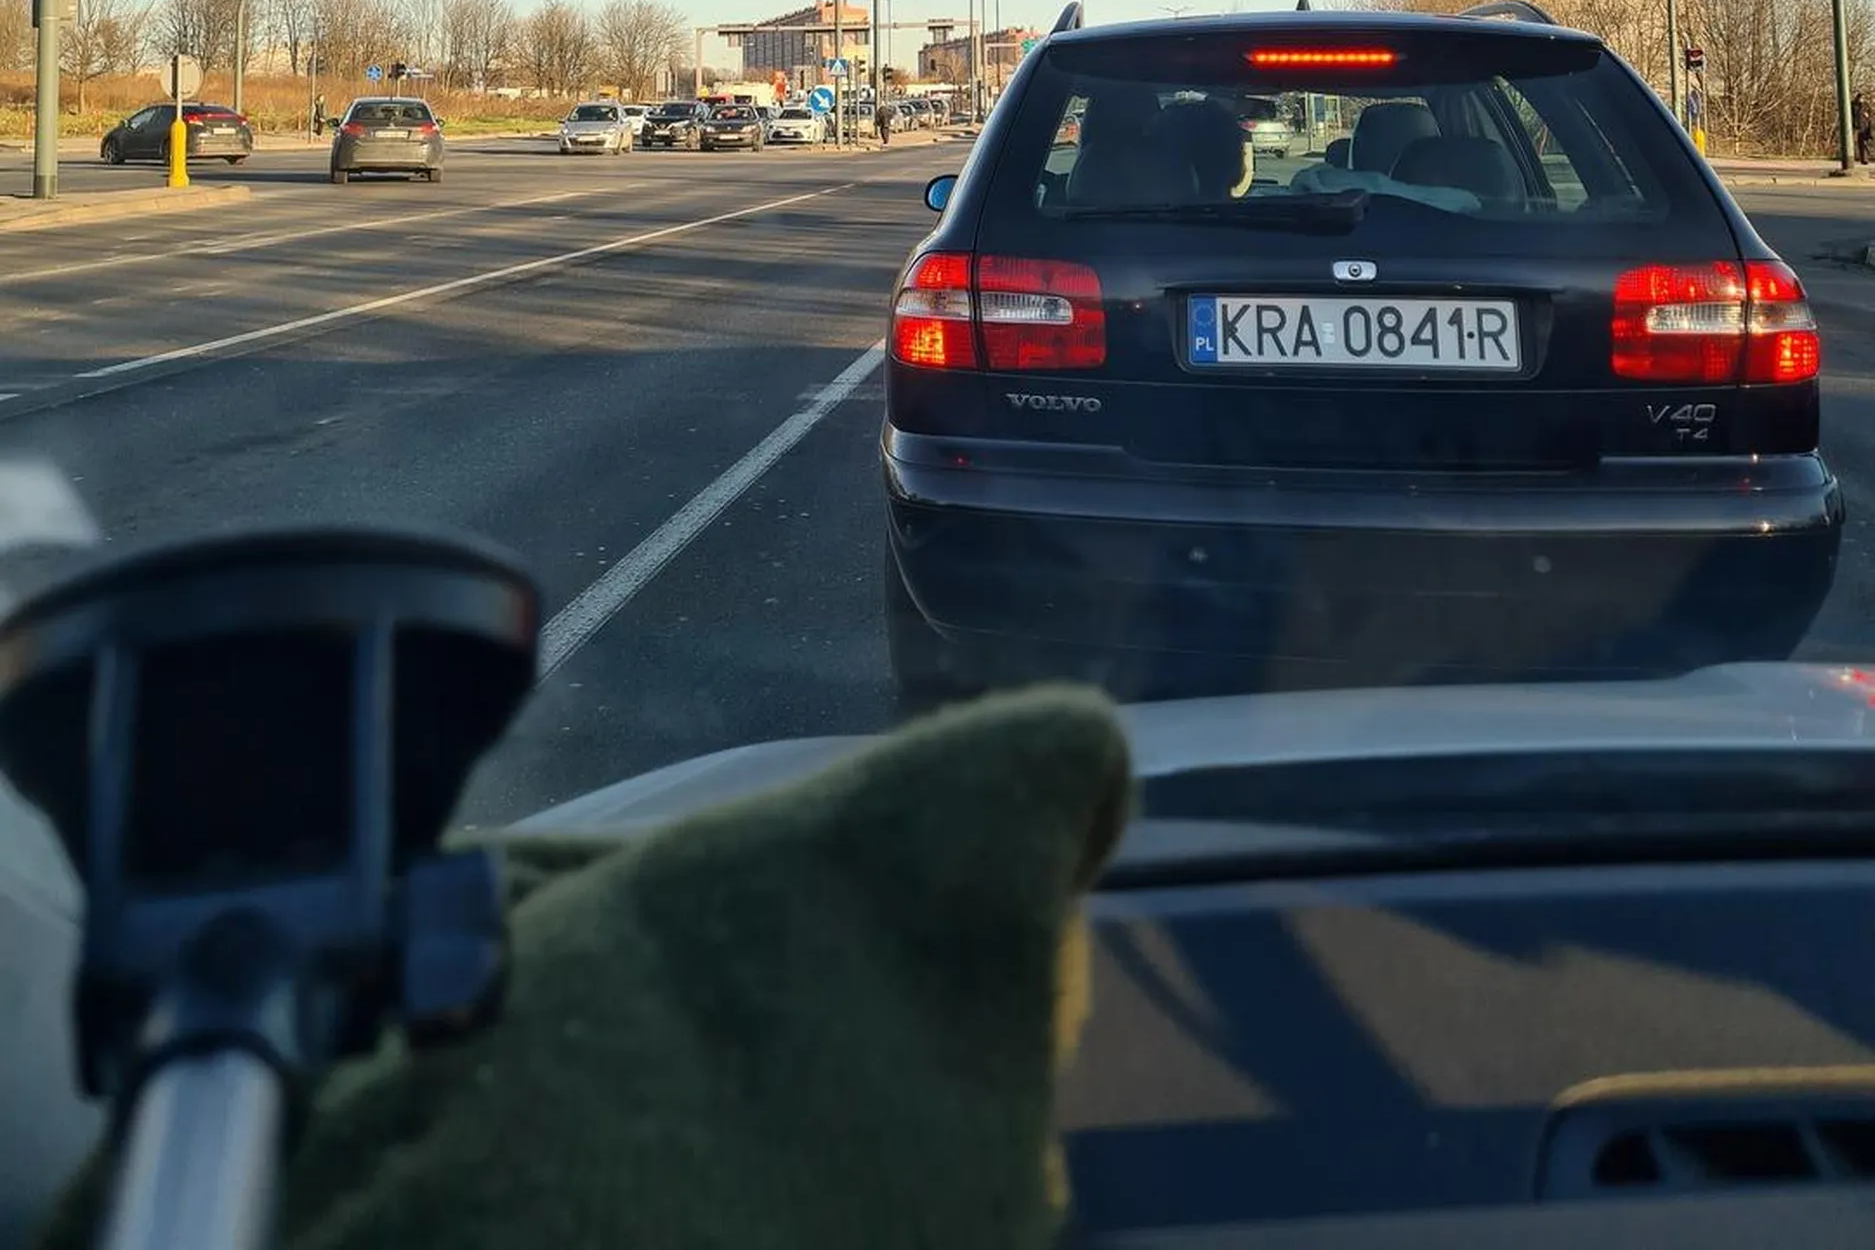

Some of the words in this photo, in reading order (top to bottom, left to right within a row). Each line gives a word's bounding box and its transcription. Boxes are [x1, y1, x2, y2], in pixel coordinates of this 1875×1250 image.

[1221, 304, 1322, 358] KRA
[1342, 305, 1510, 361] 0841R
[1195, 337, 1215, 352] PL
[1006, 393, 1102, 412] VOLVO
[1646, 403, 1717, 424] V40
[1676, 428, 1709, 441] T4
